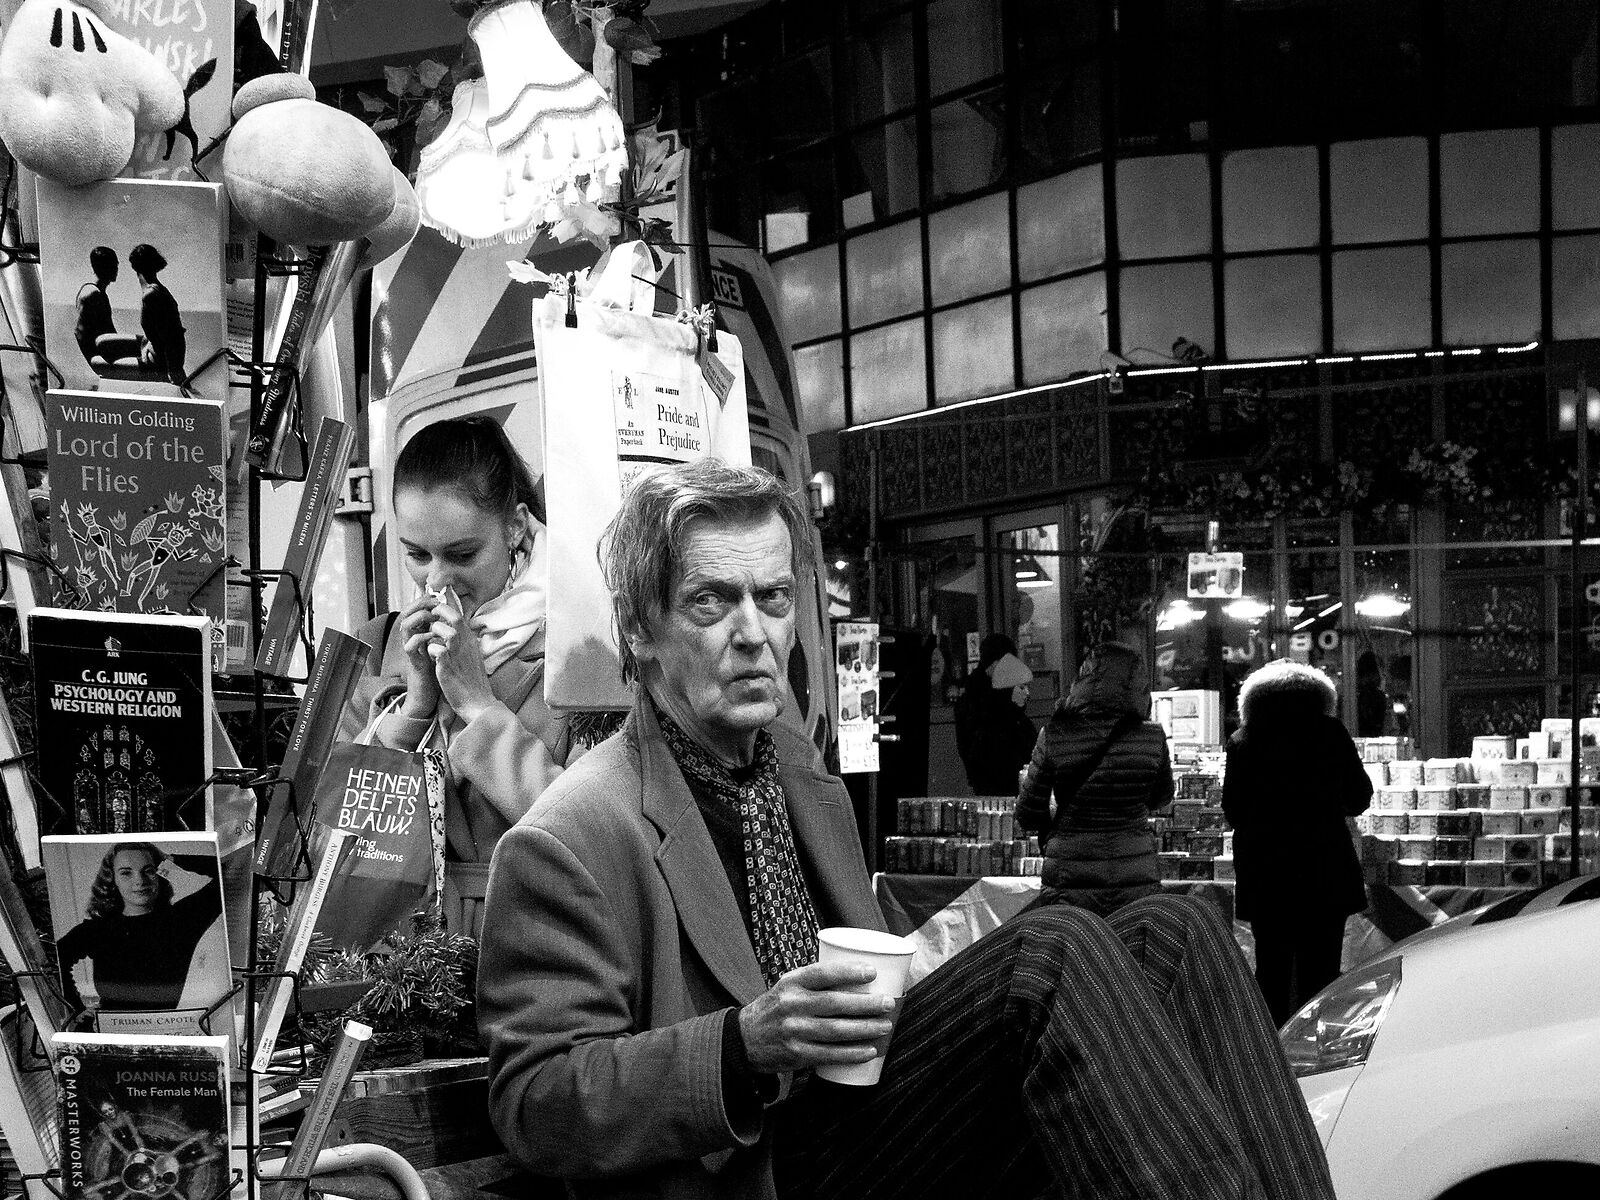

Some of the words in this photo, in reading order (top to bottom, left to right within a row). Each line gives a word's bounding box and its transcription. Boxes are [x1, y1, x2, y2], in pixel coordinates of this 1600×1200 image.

[60, 405, 123, 425] William
[128, 410, 195, 432] Golding
[259, 387, 280, 426] Madness
[657, 403, 683, 425] Pride
[685, 411, 700, 428] and
[56, 429, 119, 459] Lord
[126, 435, 156, 460] of
[161, 437, 205, 464] the
[658, 427, 701, 452] Prejudice
[81, 465, 140, 494] Flies
[308, 482, 321, 511] LETTERS
[305, 511, 313, 521] TO
[264, 638, 278, 666] VINTAGE
[321, 642, 332, 663] YUKIO
[81, 669, 96, 683] C.
[96, 671, 111, 684] G.
[112, 671, 148, 686] JUNG
[54, 683, 144, 703] PSYCHOLOGY
[146, 690, 177, 704] AND
[50, 697, 115, 715] WESTERN
[117, 703, 182, 718] RELIGION
[304, 697, 315, 719] THIRST
[293, 733, 303, 751] LOVE
[346, 767, 422, 796] HEINEN
[342, 788, 418, 816] DELFTS
[338, 807, 413, 835] BLAUW.
[356, 847, 404, 863] traditions
[111, 1017, 152, 1027] TRUMAN
[156, 1016, 196, 1026] CAPOTE
[115, 1071, 176, 1085] JOANNA
[179, 1071, 217, 1083] RUSS
[126, 1086, 147, 1098] The
[150, 1086, 191, 1098] Female
[193, 1087, 218, 1098] Man
[65, 1078, 84, 1188] MASTERWORKS
